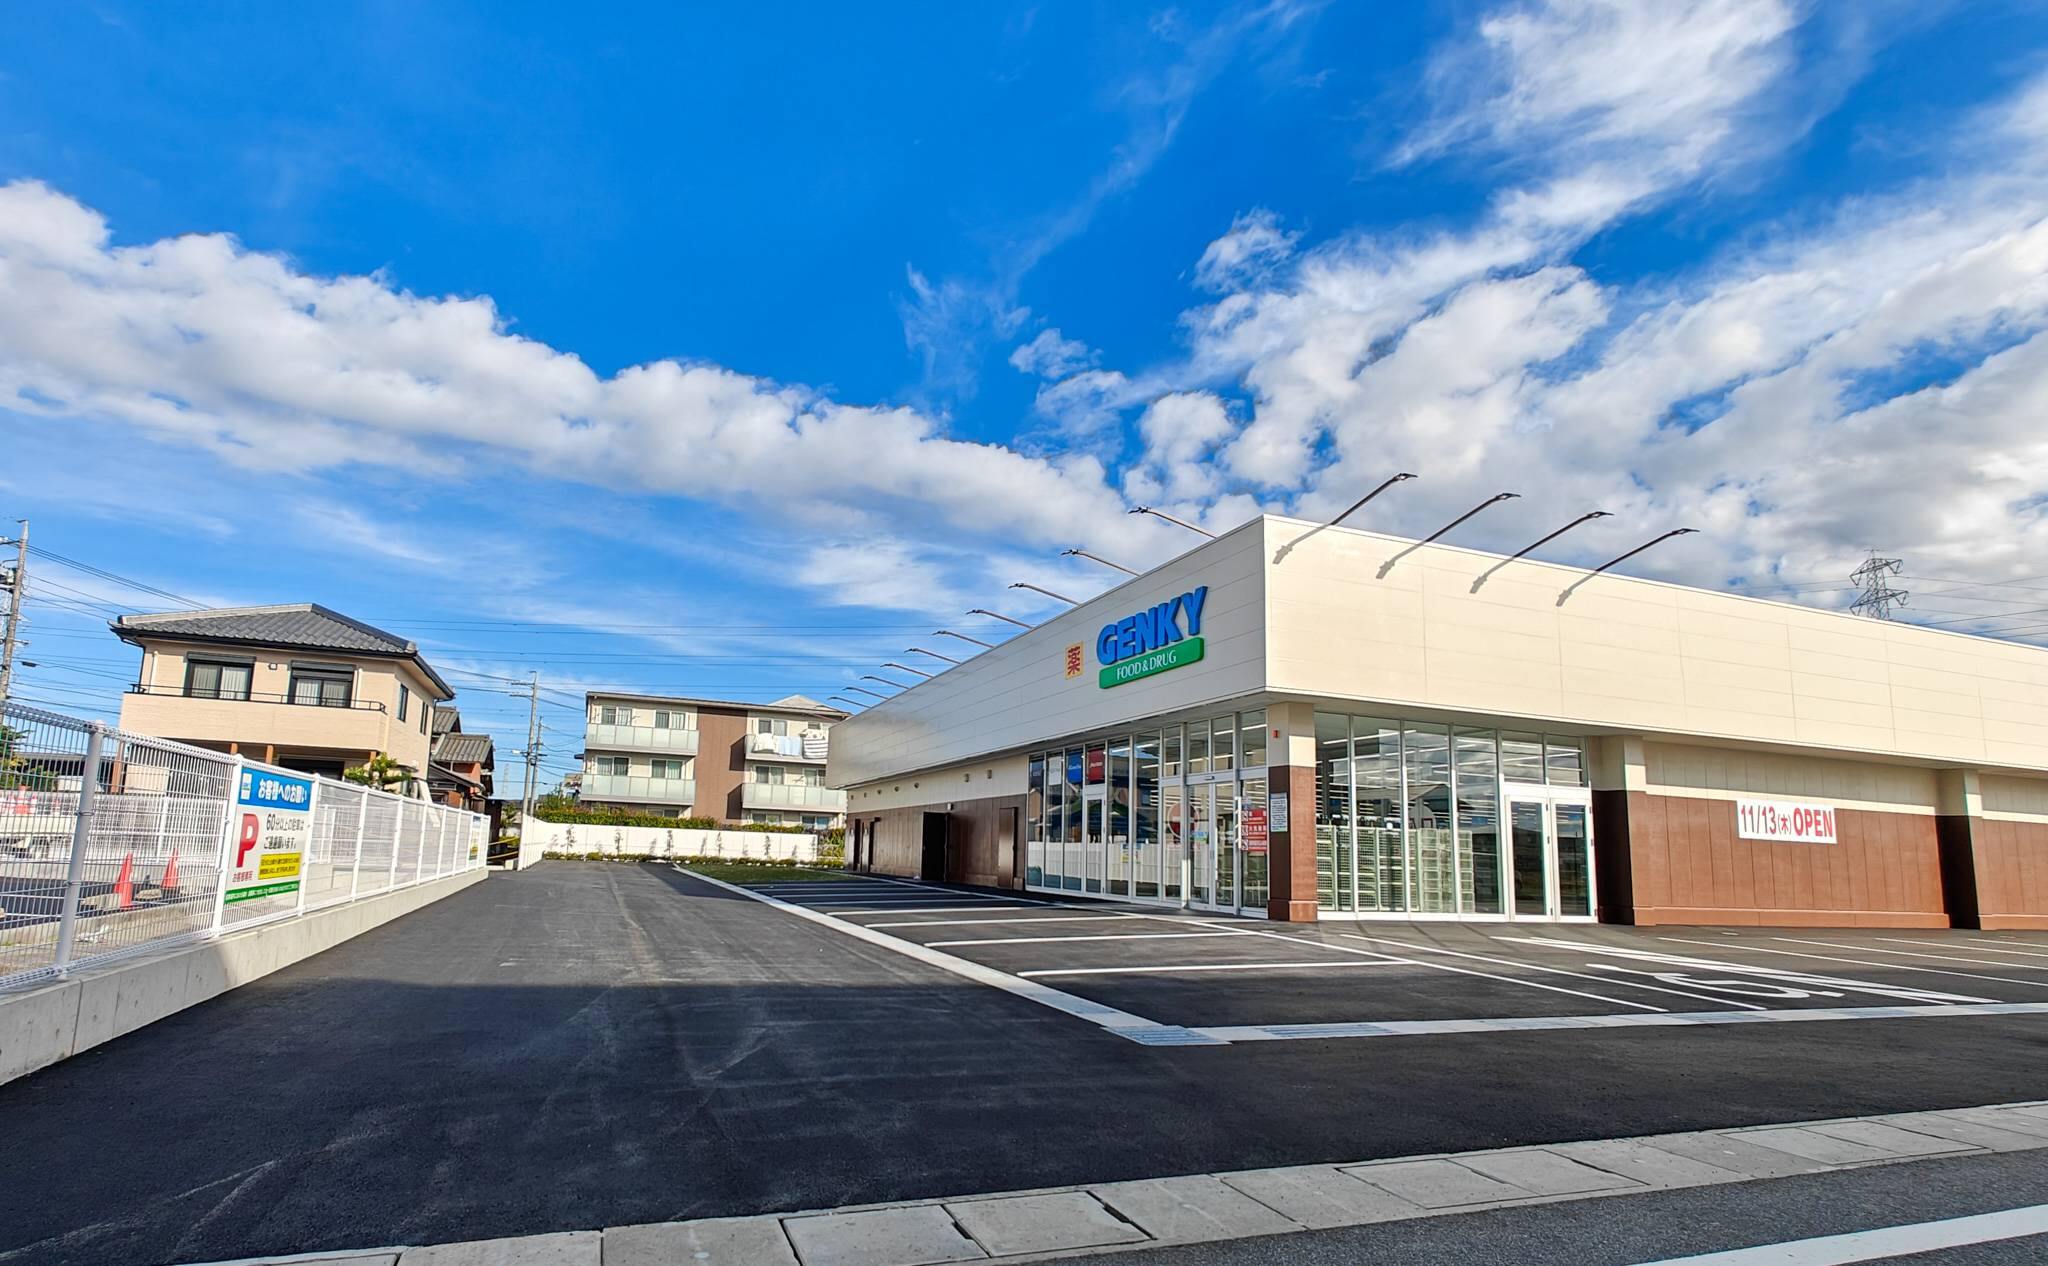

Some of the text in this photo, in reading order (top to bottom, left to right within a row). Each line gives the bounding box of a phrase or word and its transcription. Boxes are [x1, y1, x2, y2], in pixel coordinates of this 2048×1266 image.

[1096, 586, 1208, 665] GENKY
[1067, 646, 1081, 675] 薬
[258, 778, 307, 803] お客様へのお願い
[1793, 807, 1833, 837] OPEN
[236, 813, 259, 868] P
